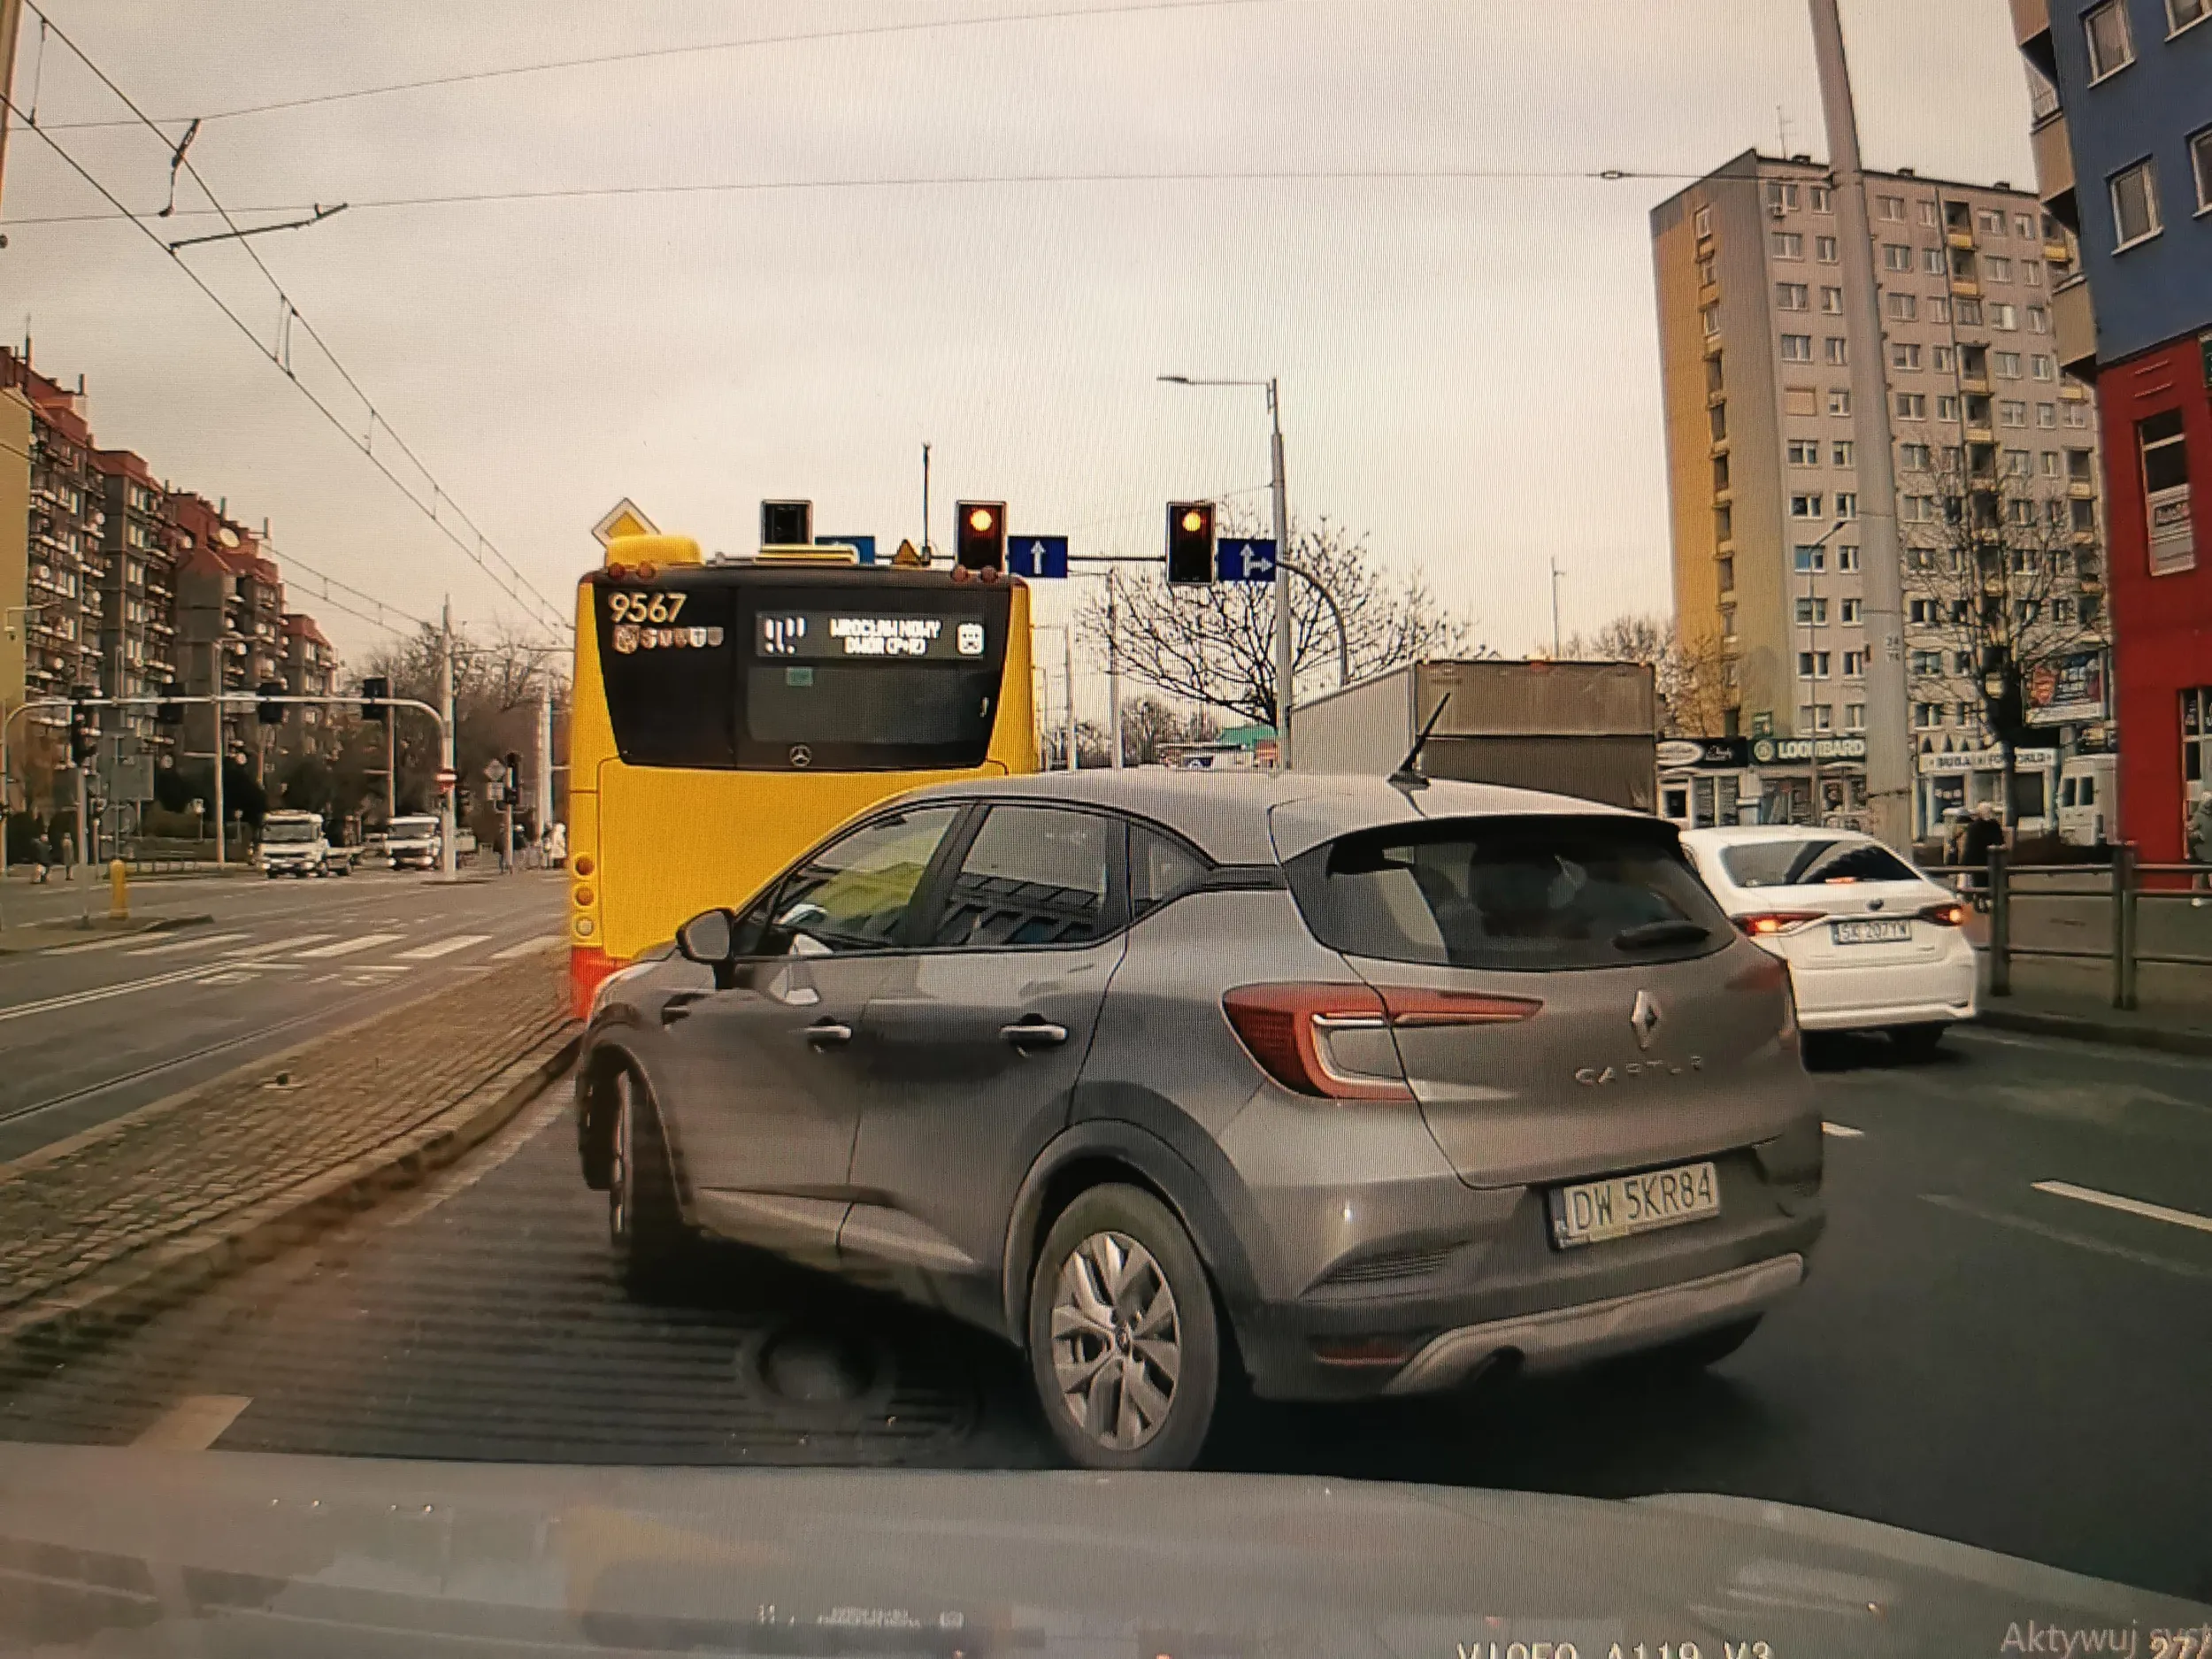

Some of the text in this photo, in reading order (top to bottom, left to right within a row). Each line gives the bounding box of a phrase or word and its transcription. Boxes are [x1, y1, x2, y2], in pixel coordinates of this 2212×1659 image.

[608, 592, 687, 623] 9567
[1571, 1167, 1711, 1231] DW 5KR84
